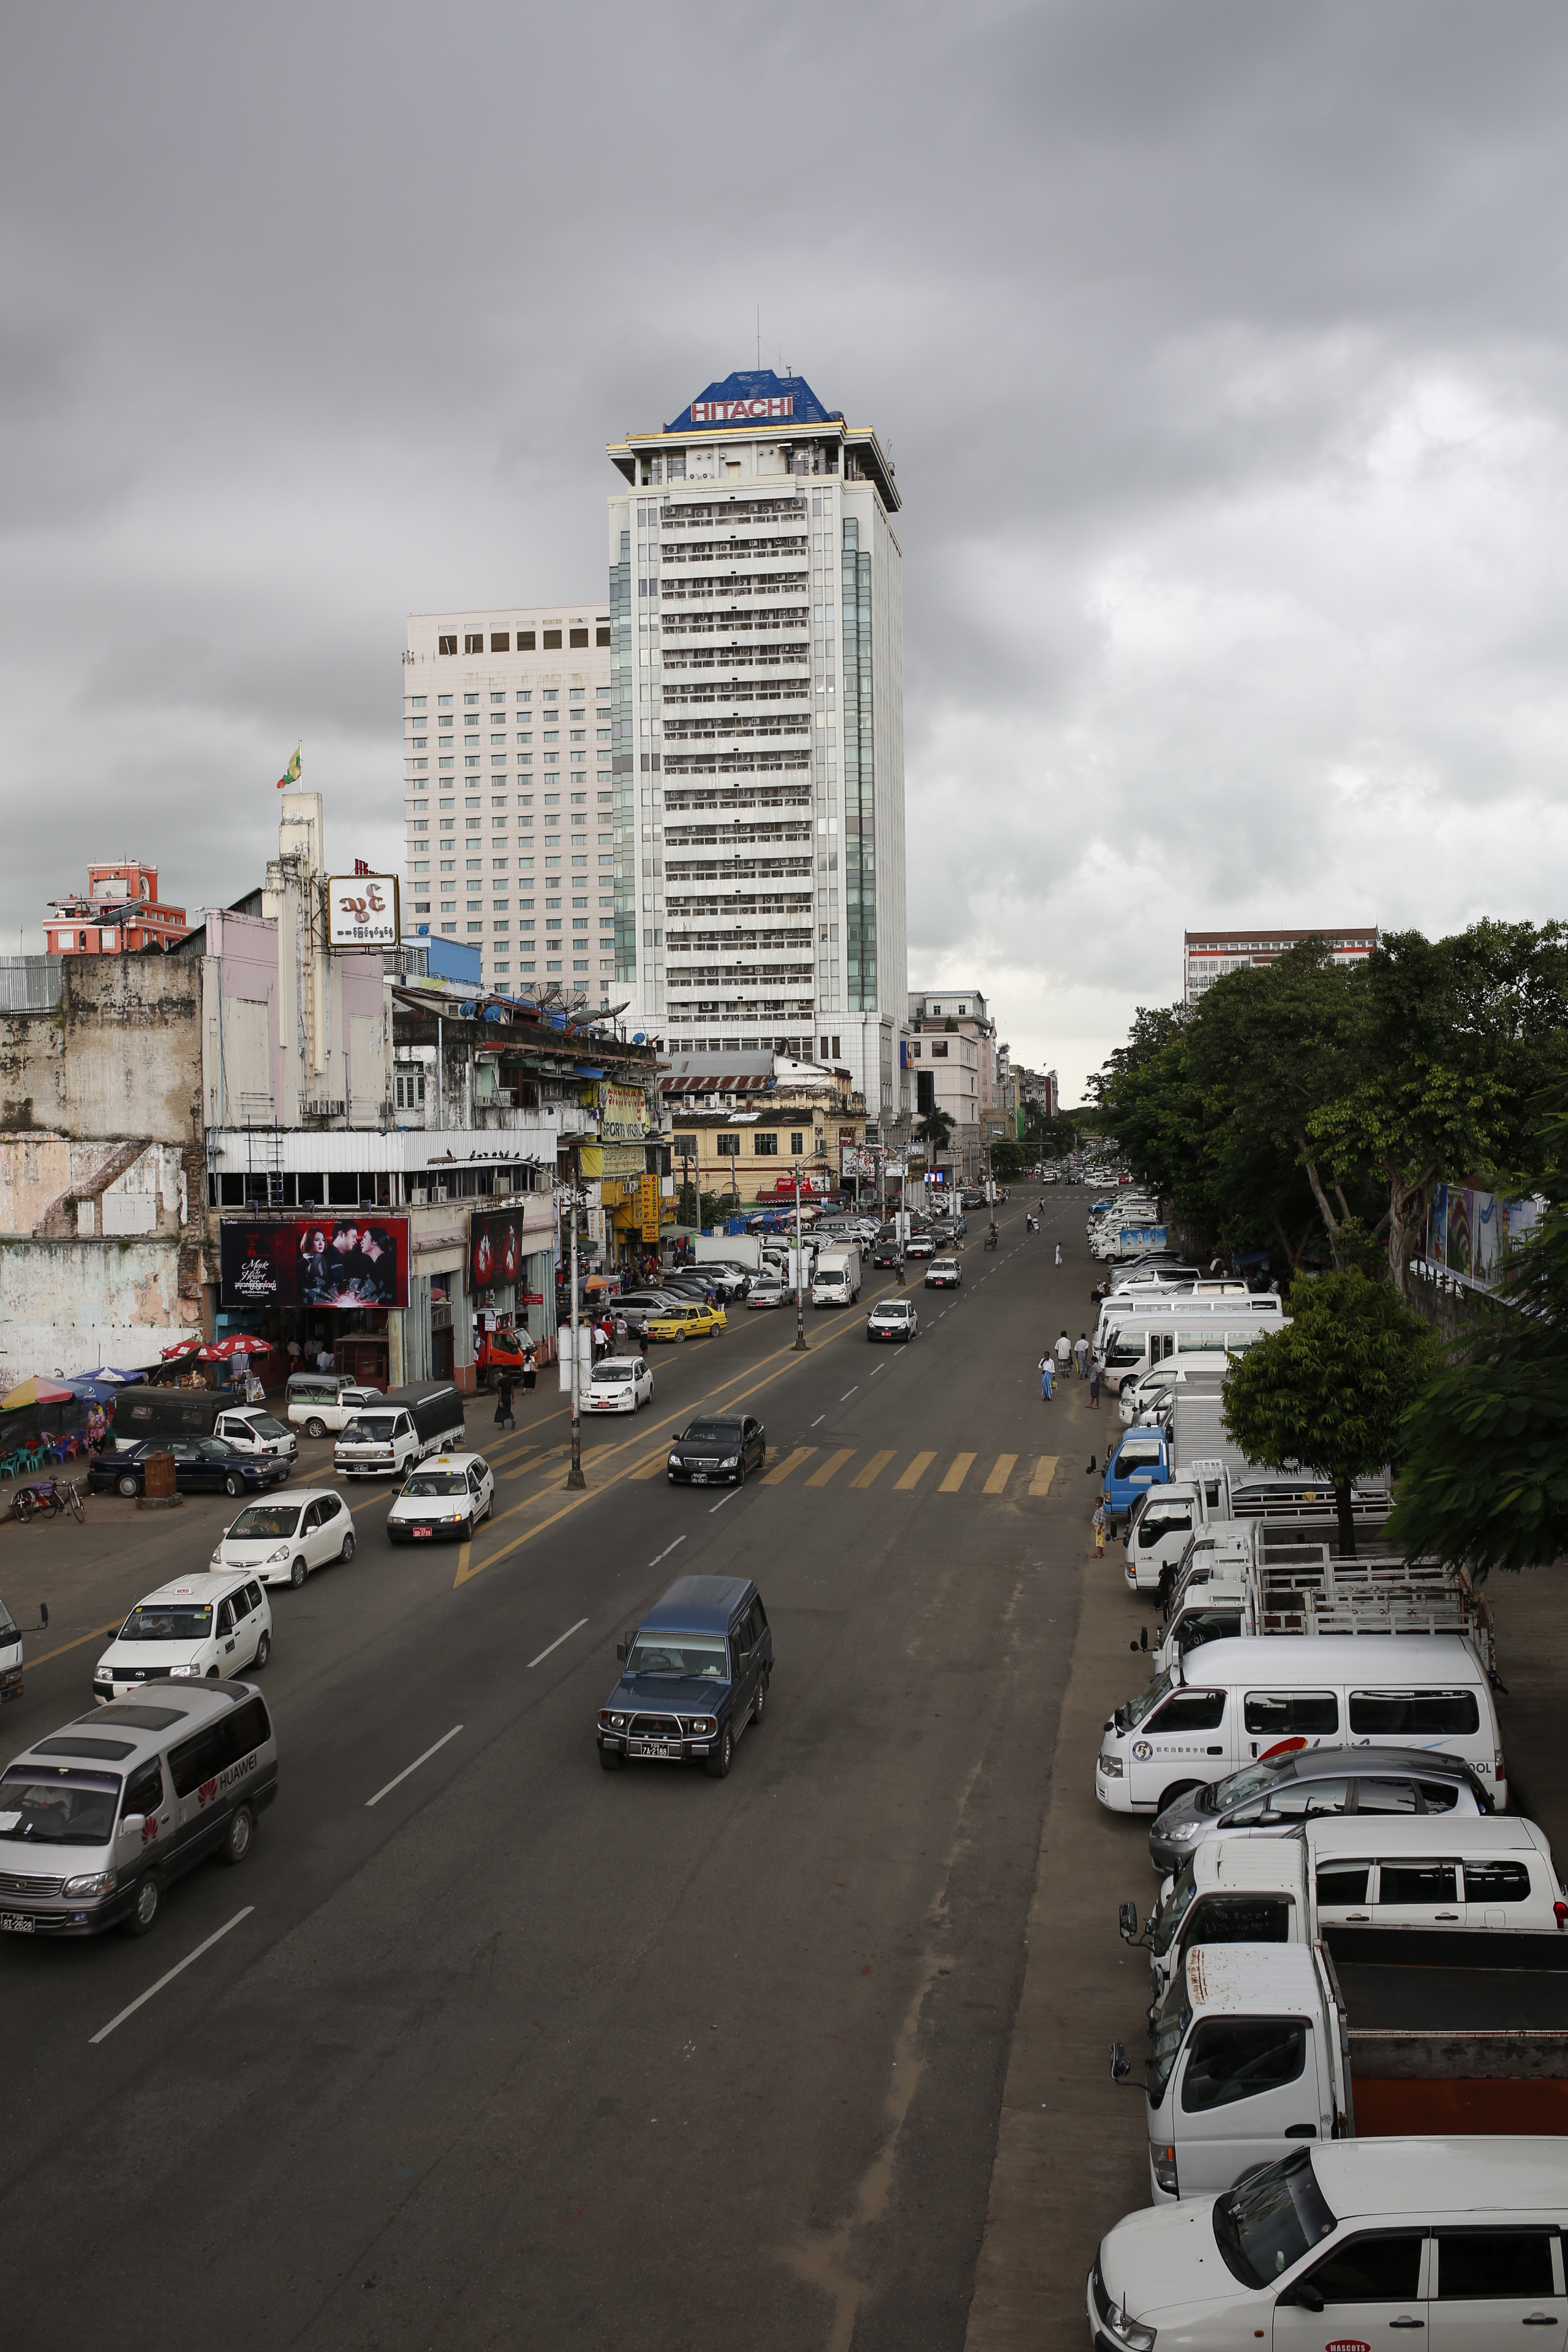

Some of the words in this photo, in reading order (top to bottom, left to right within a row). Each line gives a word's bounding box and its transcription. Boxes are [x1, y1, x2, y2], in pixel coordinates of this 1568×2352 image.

[692, 398, 793, 421] HITACHI
[339, 883, 386, 922] သွင်
[603, 1122, 625, 1137] SPORTS
[241, 1259, 269, 1270] Made
[241, 1270, 266, 1281] Heart
[643, 1747, 667, 1755] 7A-2188
[220, 1753, 257, 1790] HUAWEI
